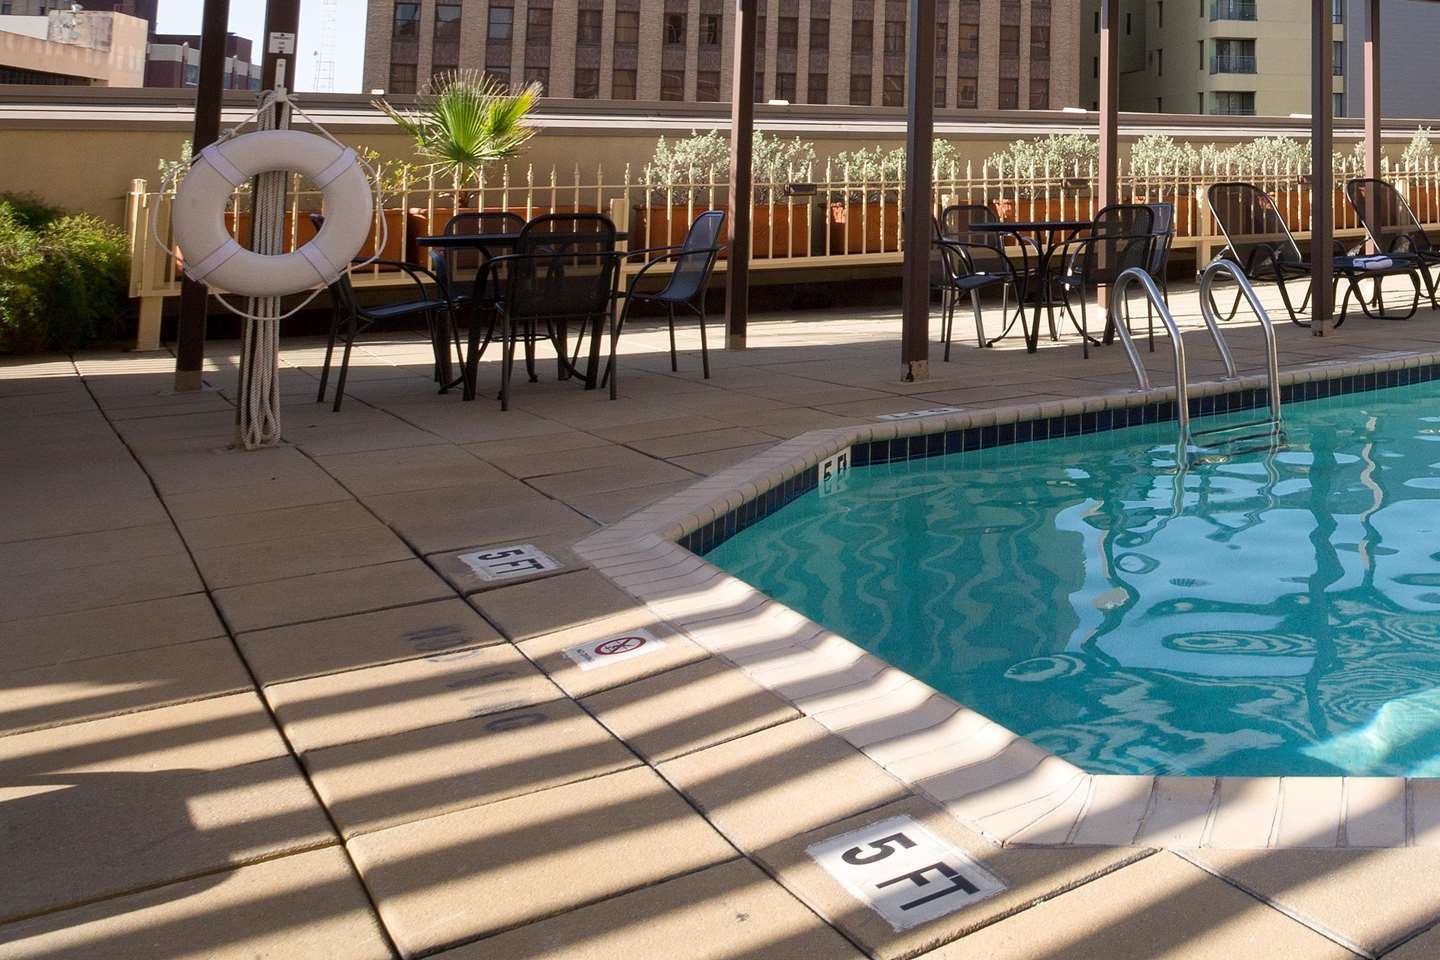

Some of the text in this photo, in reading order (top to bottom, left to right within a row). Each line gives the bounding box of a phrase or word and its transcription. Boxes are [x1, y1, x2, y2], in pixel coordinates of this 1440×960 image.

[477, 548, 545, 575] 5 FT
[841, 831, 981, 913] 5 FT
